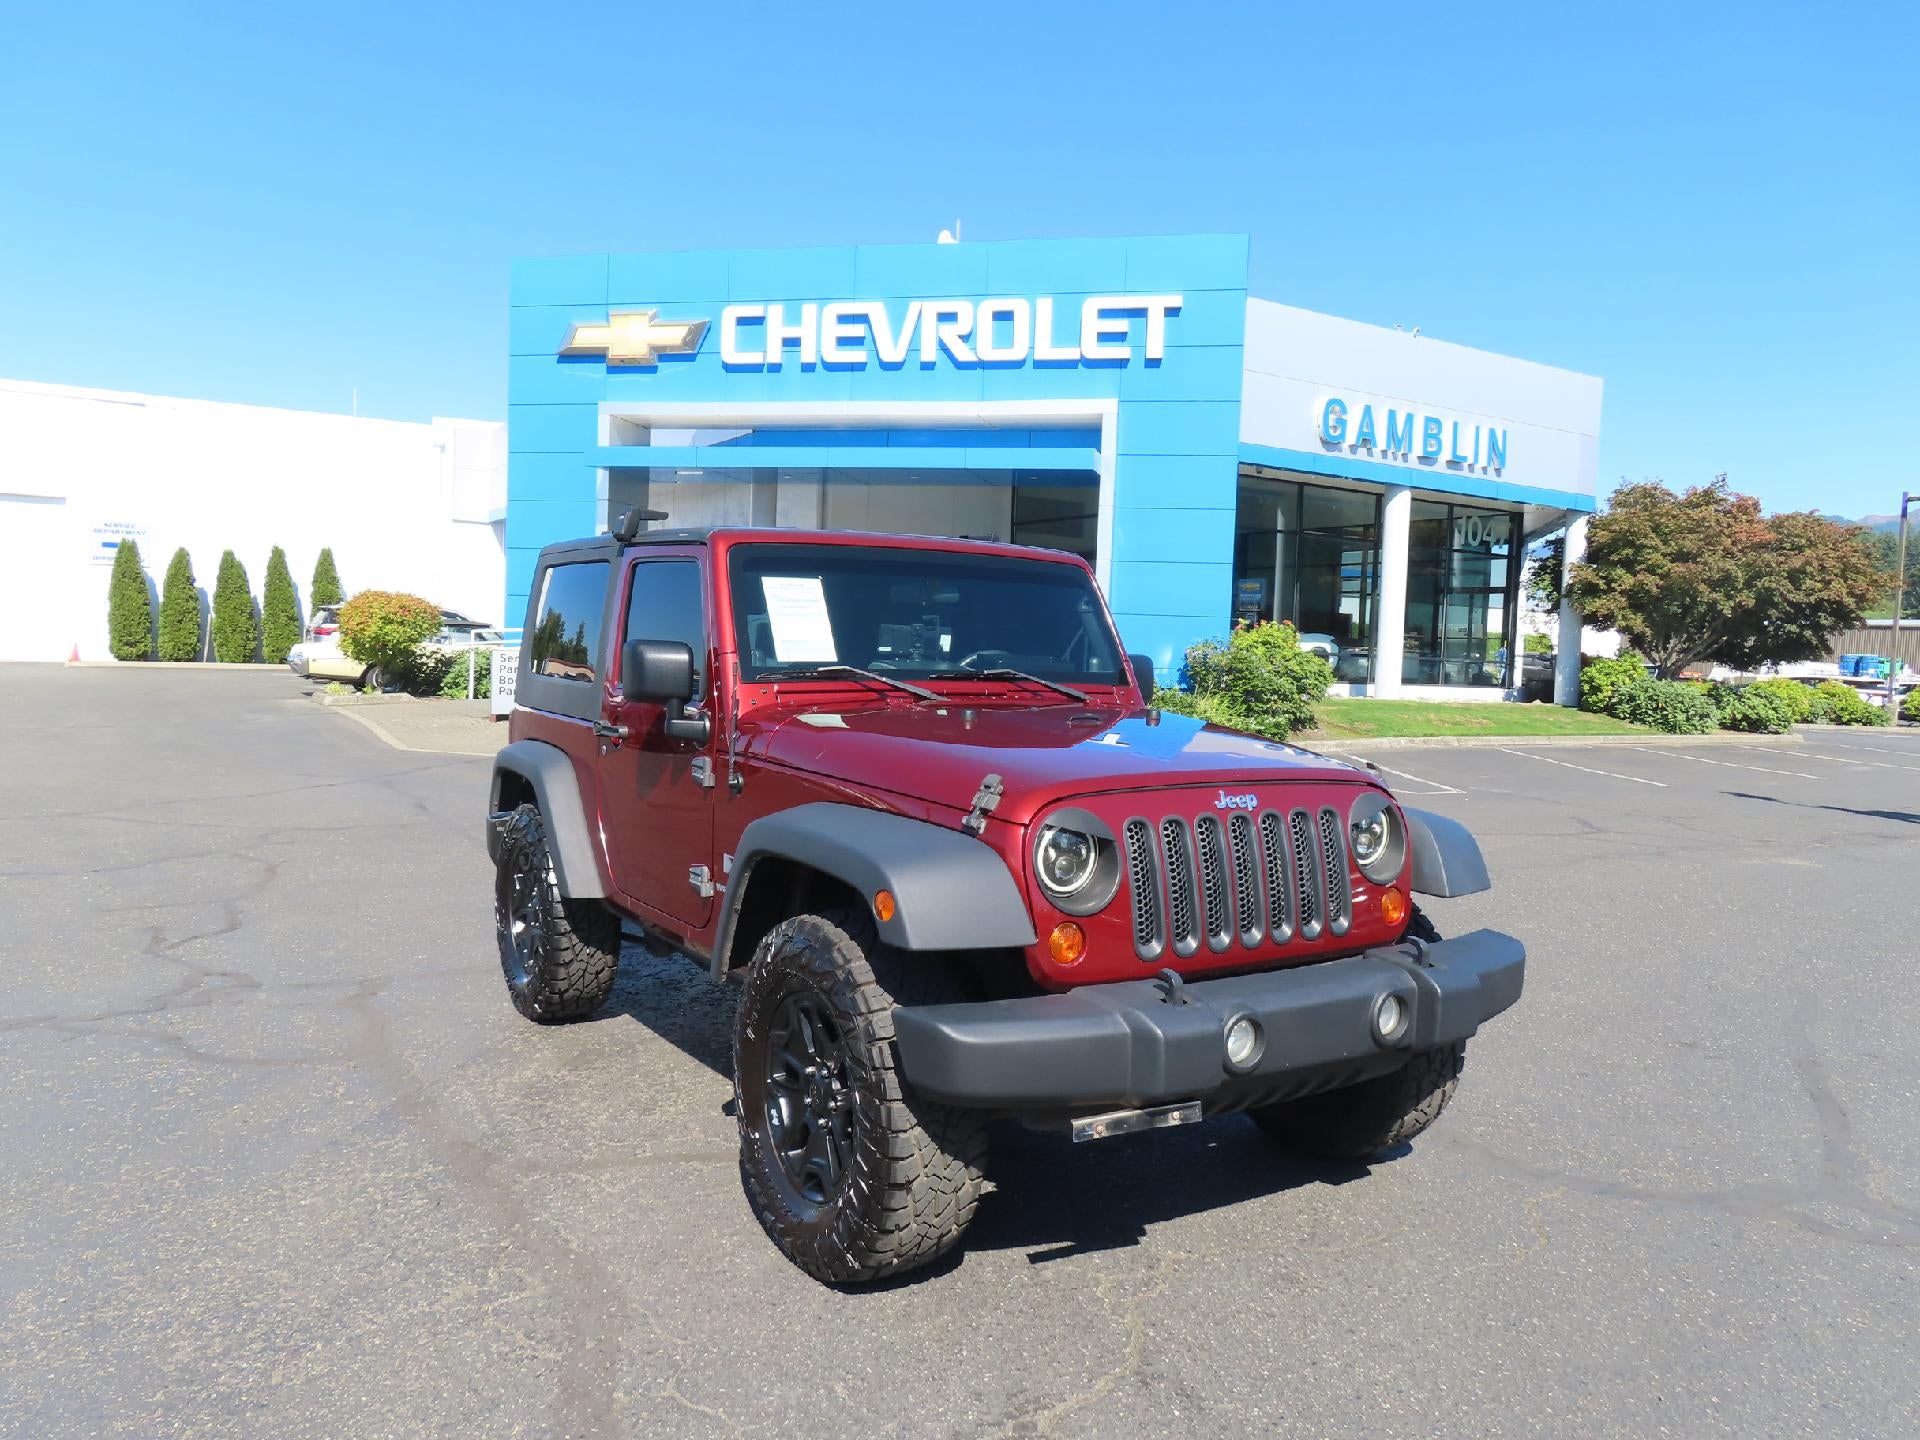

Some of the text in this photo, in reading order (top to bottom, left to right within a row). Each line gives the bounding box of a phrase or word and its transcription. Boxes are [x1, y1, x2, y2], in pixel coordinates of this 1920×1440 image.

[720, 295, 1183, 367] CHEVROLET
[1322, 397, 1507, 470] GAMBLIN
[1214, 789, 1258, 811] Jeep
